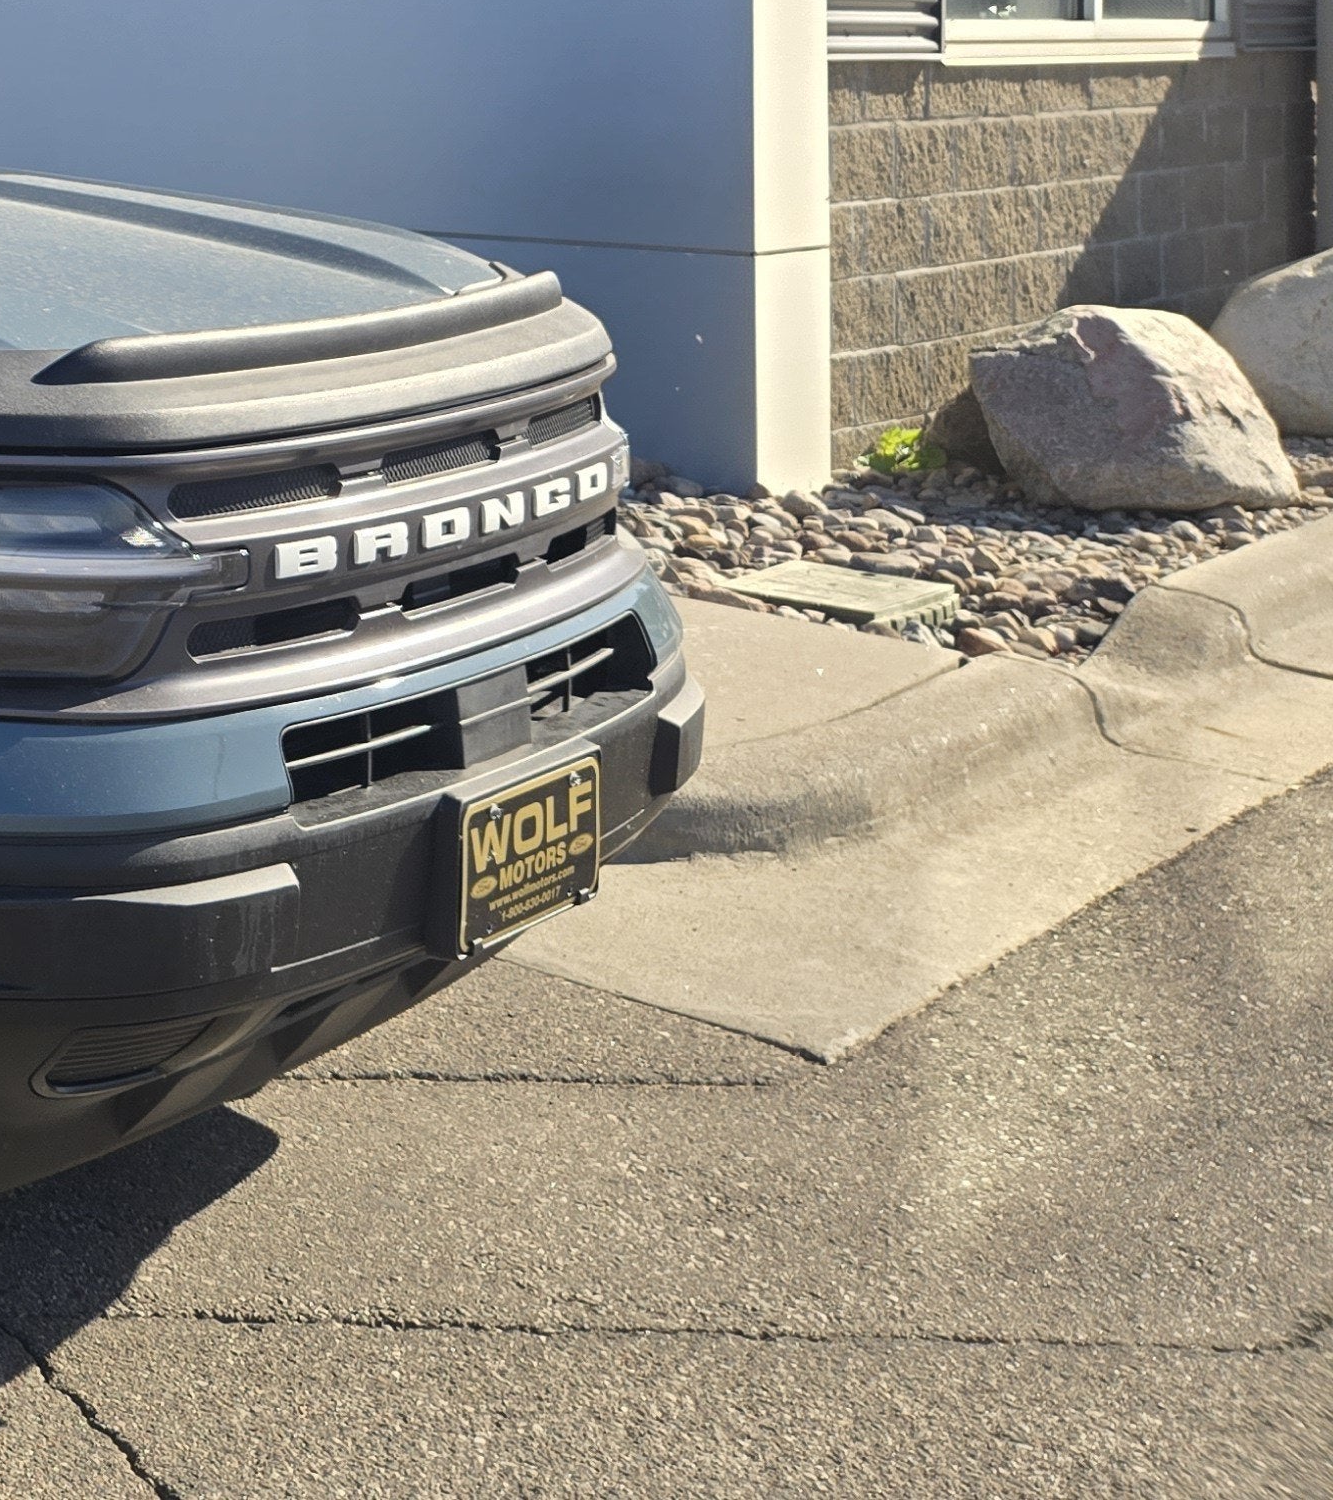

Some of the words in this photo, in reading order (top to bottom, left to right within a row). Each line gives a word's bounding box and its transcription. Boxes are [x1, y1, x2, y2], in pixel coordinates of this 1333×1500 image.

[275, 461, 608, 579] BRONCO
[471, 780, 592, 874] WOLF
[499, 841, 567, 891] MOTORS
